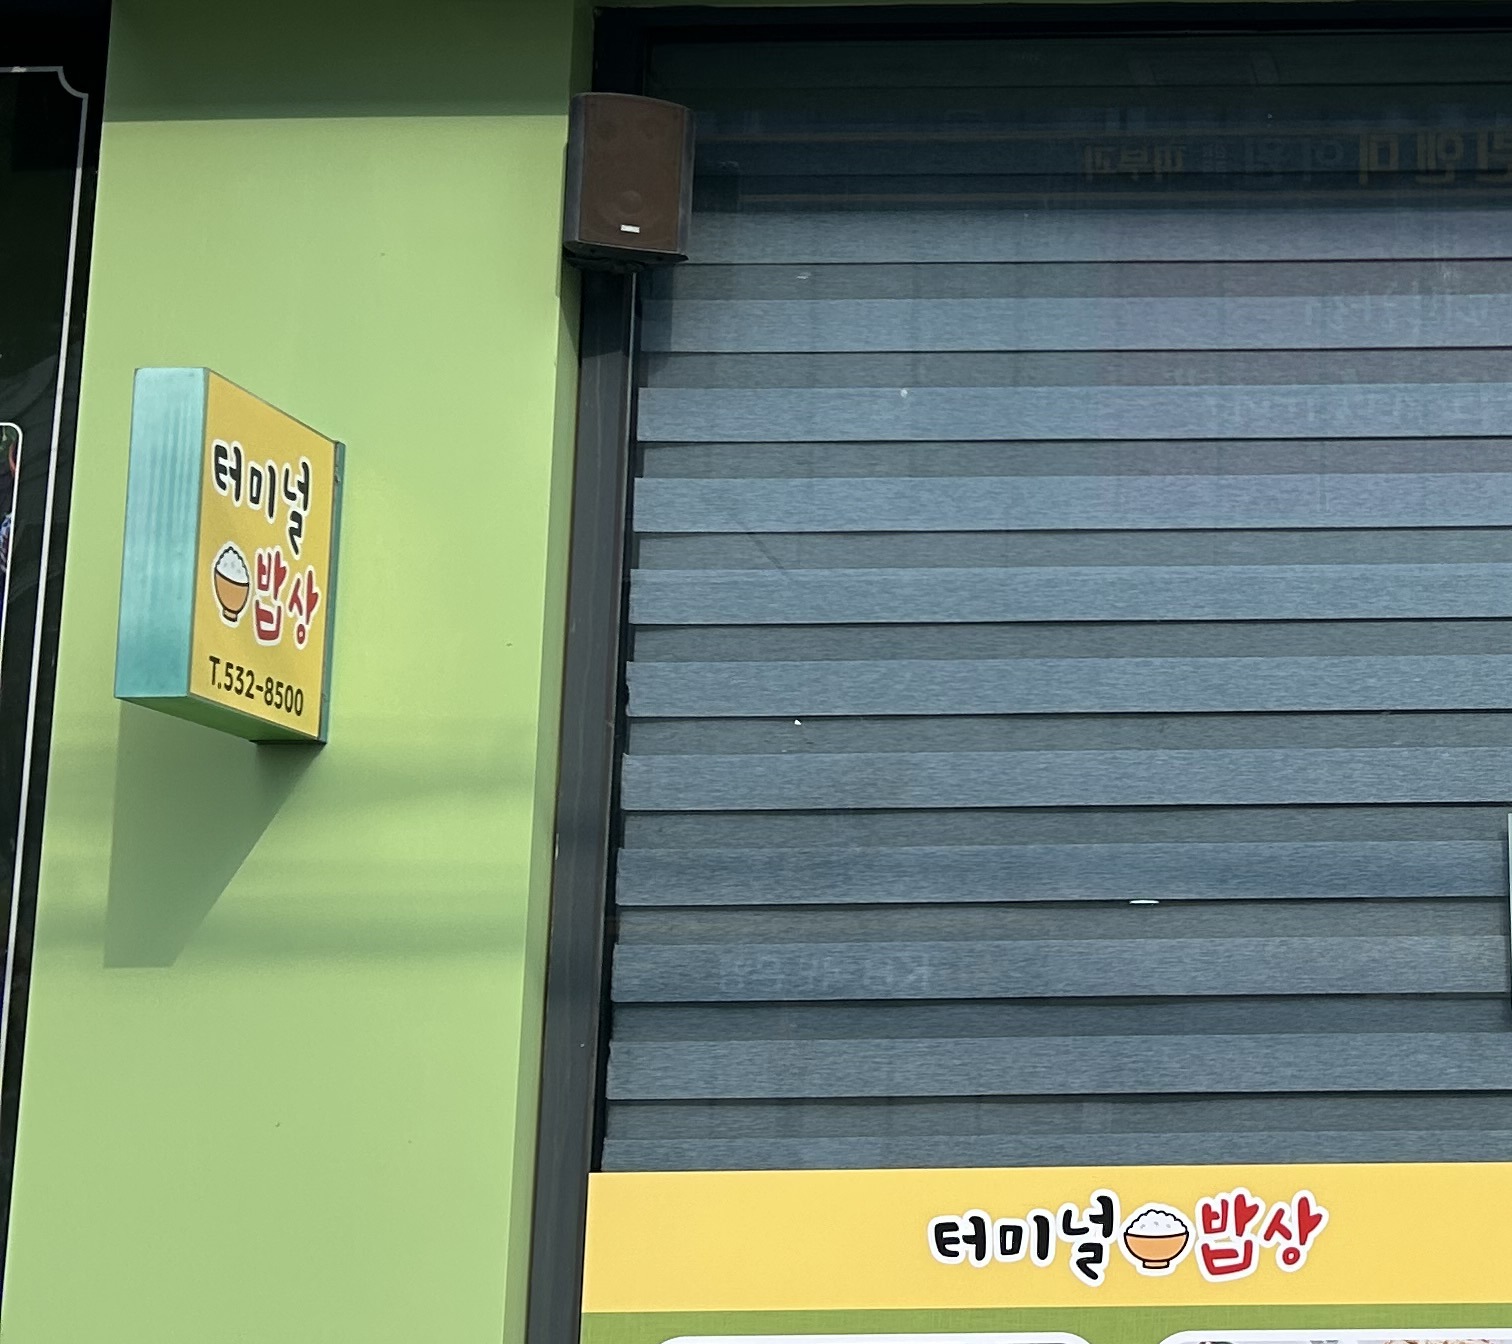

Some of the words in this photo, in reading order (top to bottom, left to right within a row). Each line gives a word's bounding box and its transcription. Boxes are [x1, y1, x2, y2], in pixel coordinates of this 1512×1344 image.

[214, 442, 311, 555] 터미널
[255, 550, 319, 645] 밥상
[208, 656, 304, 717] T.532-8500
[933, 1193, 1116, 1282] 터미널
[1201, 1192, 1326, 1277] 밥상
